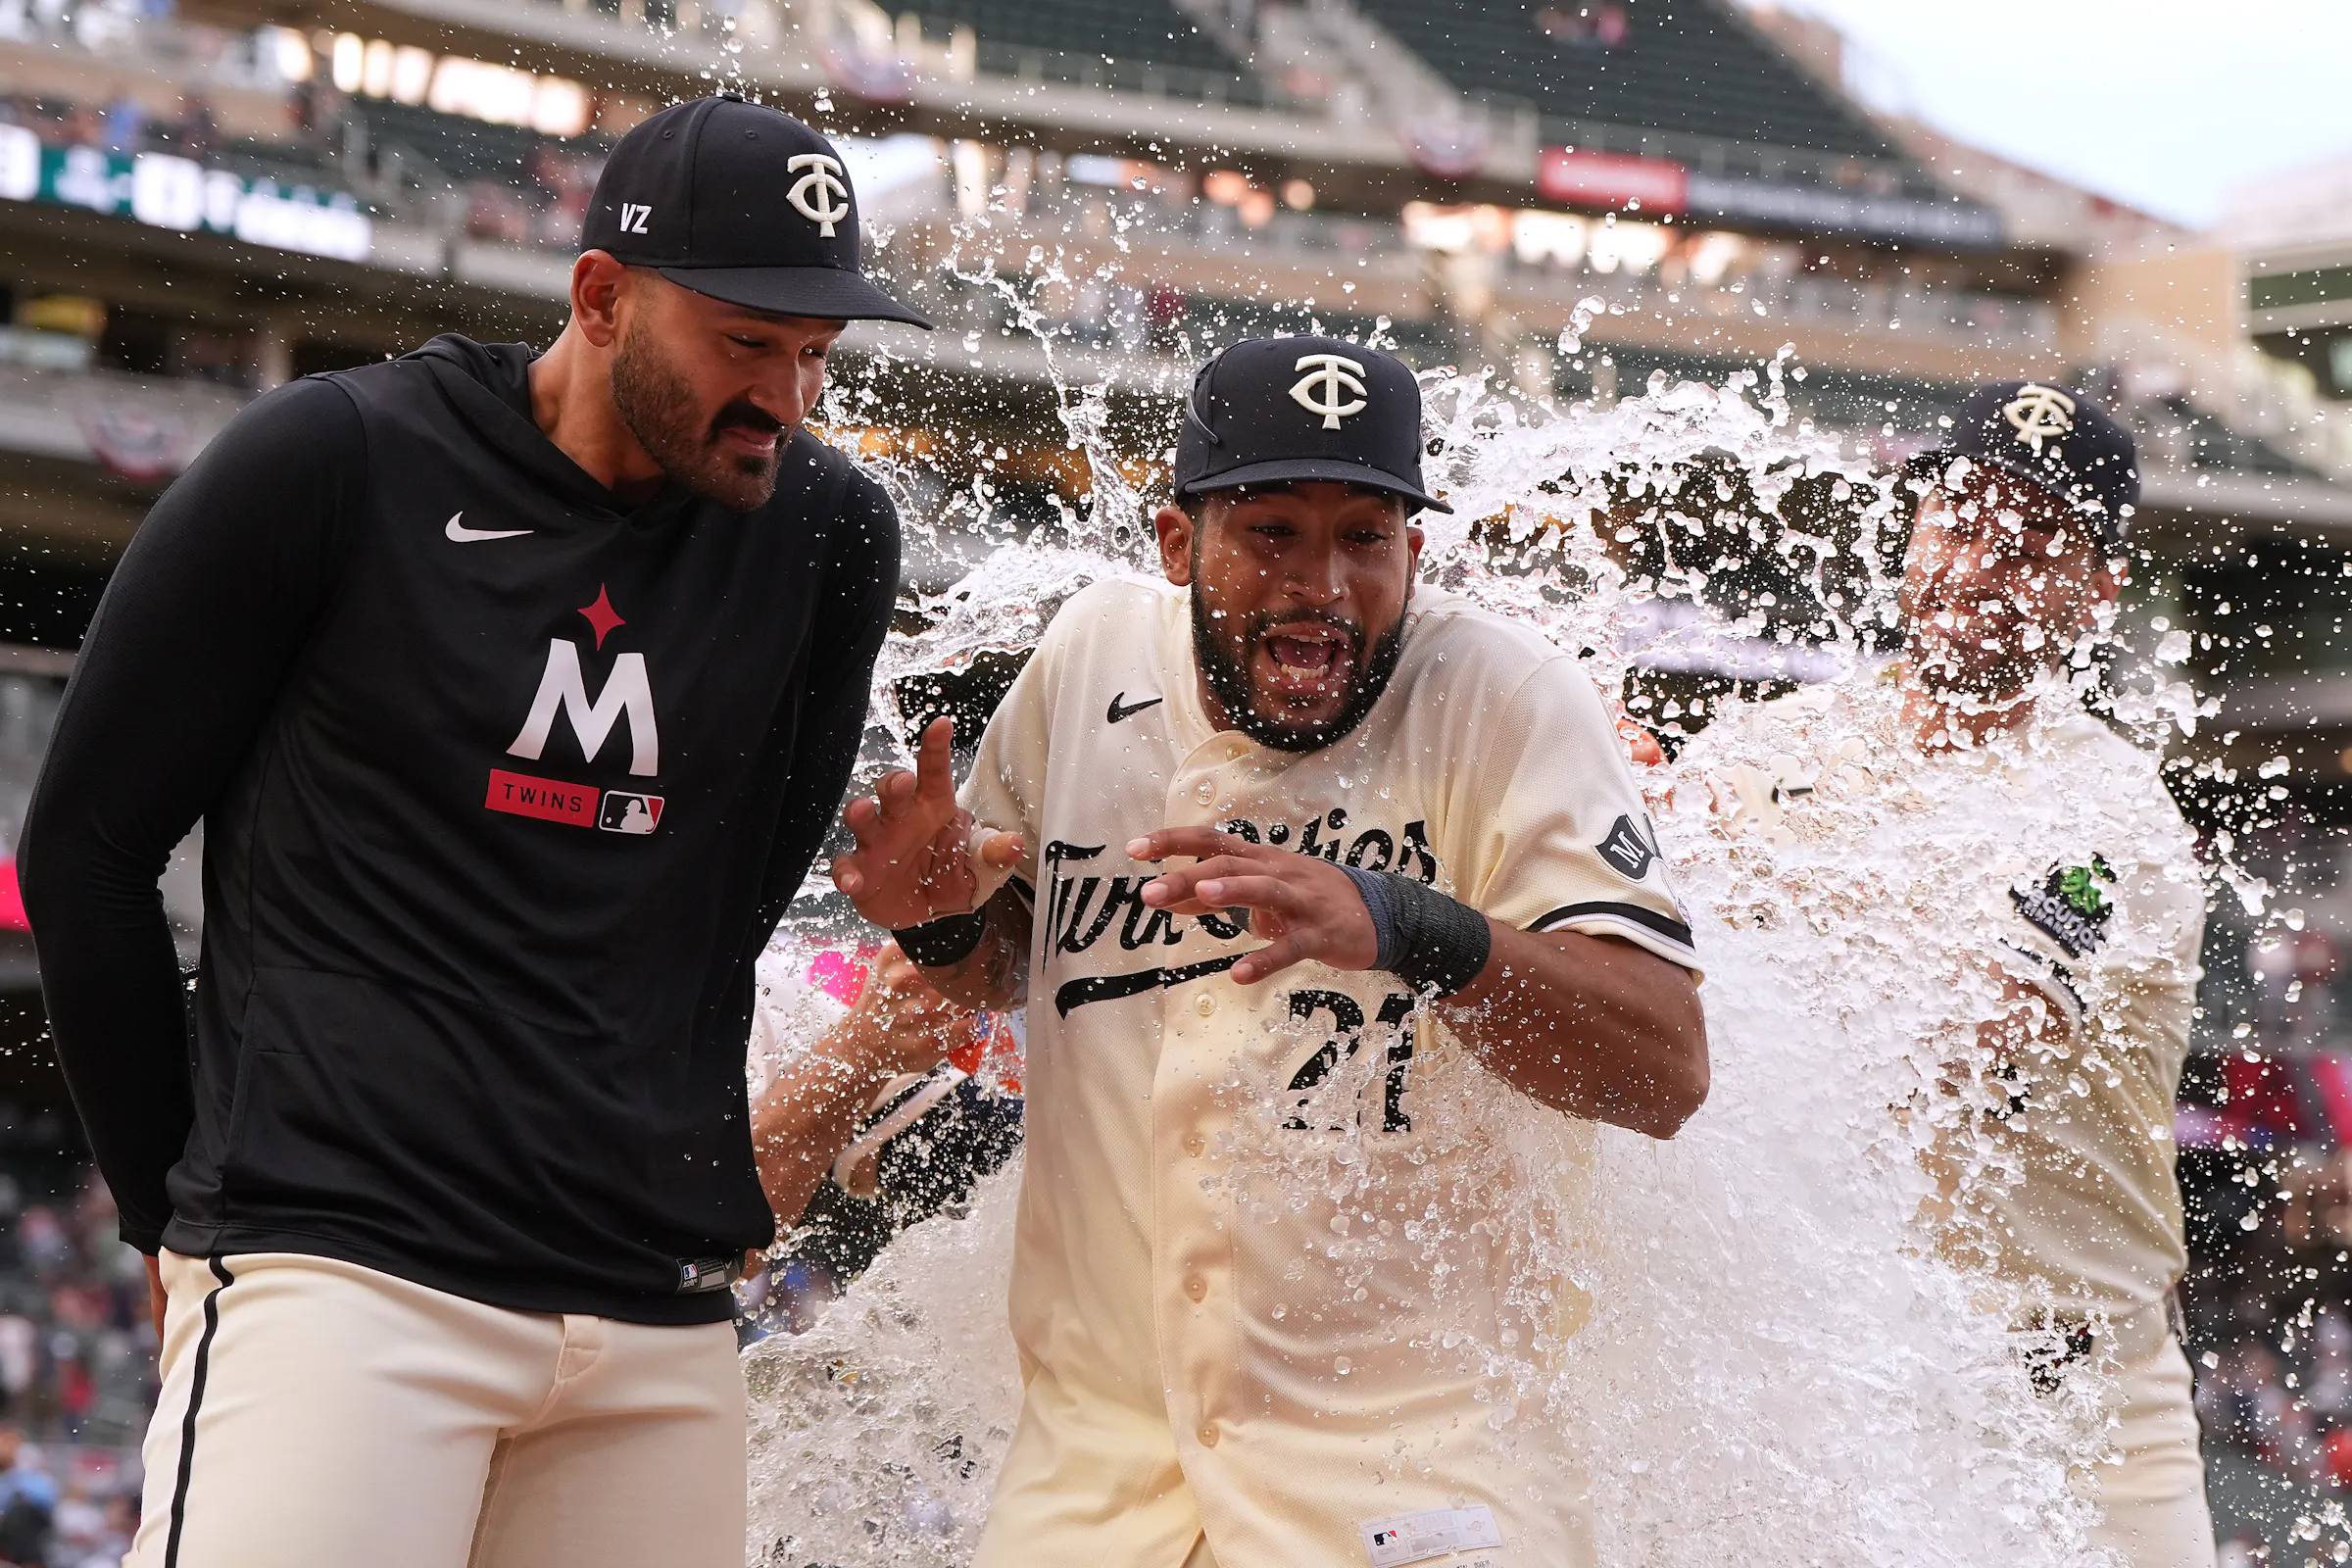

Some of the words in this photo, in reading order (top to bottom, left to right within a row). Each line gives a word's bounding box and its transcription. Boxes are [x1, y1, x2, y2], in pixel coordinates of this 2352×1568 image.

[619, 203, 652, 234] VZ
[506, 638, 659, 776] M
[503, 783, 582, 812] TWINS
[1609, 831, 1644, 869] M
[1283, 990, 1415, 1132] 21
